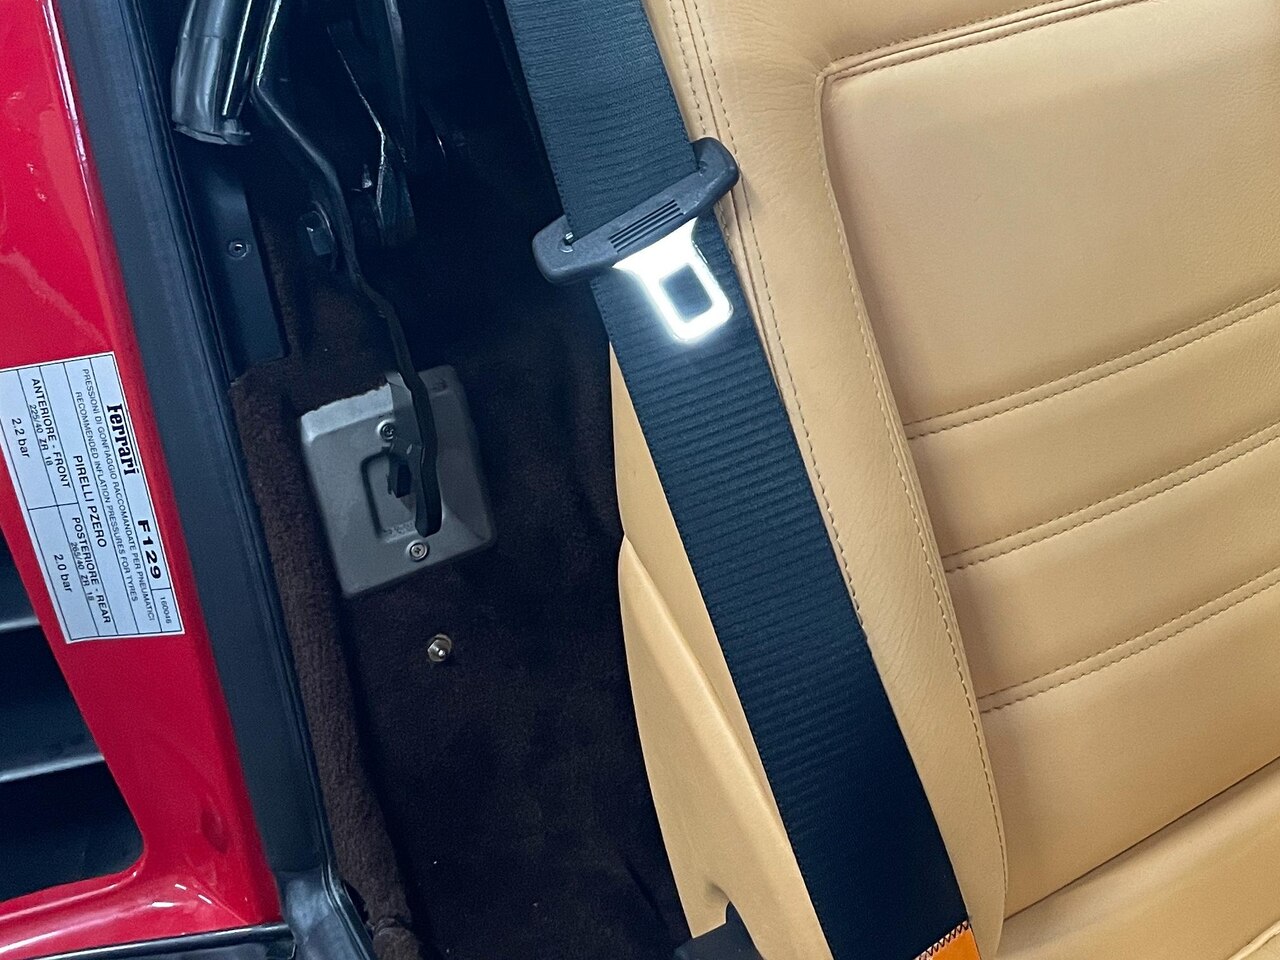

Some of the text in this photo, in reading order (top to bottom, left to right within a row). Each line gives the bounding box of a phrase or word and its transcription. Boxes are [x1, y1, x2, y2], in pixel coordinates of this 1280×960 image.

[11, 418, 30, 457] 2.2 bar
[31, 379, 57, 441] ANTERIORE
[53, 452, 71, 488] FRONT
[106, 403, 139, 475] Ferrari
[73, 455, 107, 547] PIRELLI PZERO
[75, 392, 138, 602] RECOMMENDED INFLATION PRESSURES FOR TYRES
[82, 369, 155, 621] PRESSIONI DI GONFIAGGIO RACCOMANDATE PER PNEUMATICI
[54, 554, 72, 592] 2.0 bar
[72, 517, 99, 585] POSTERIORE
[96, 595, 111, 623] REAR
